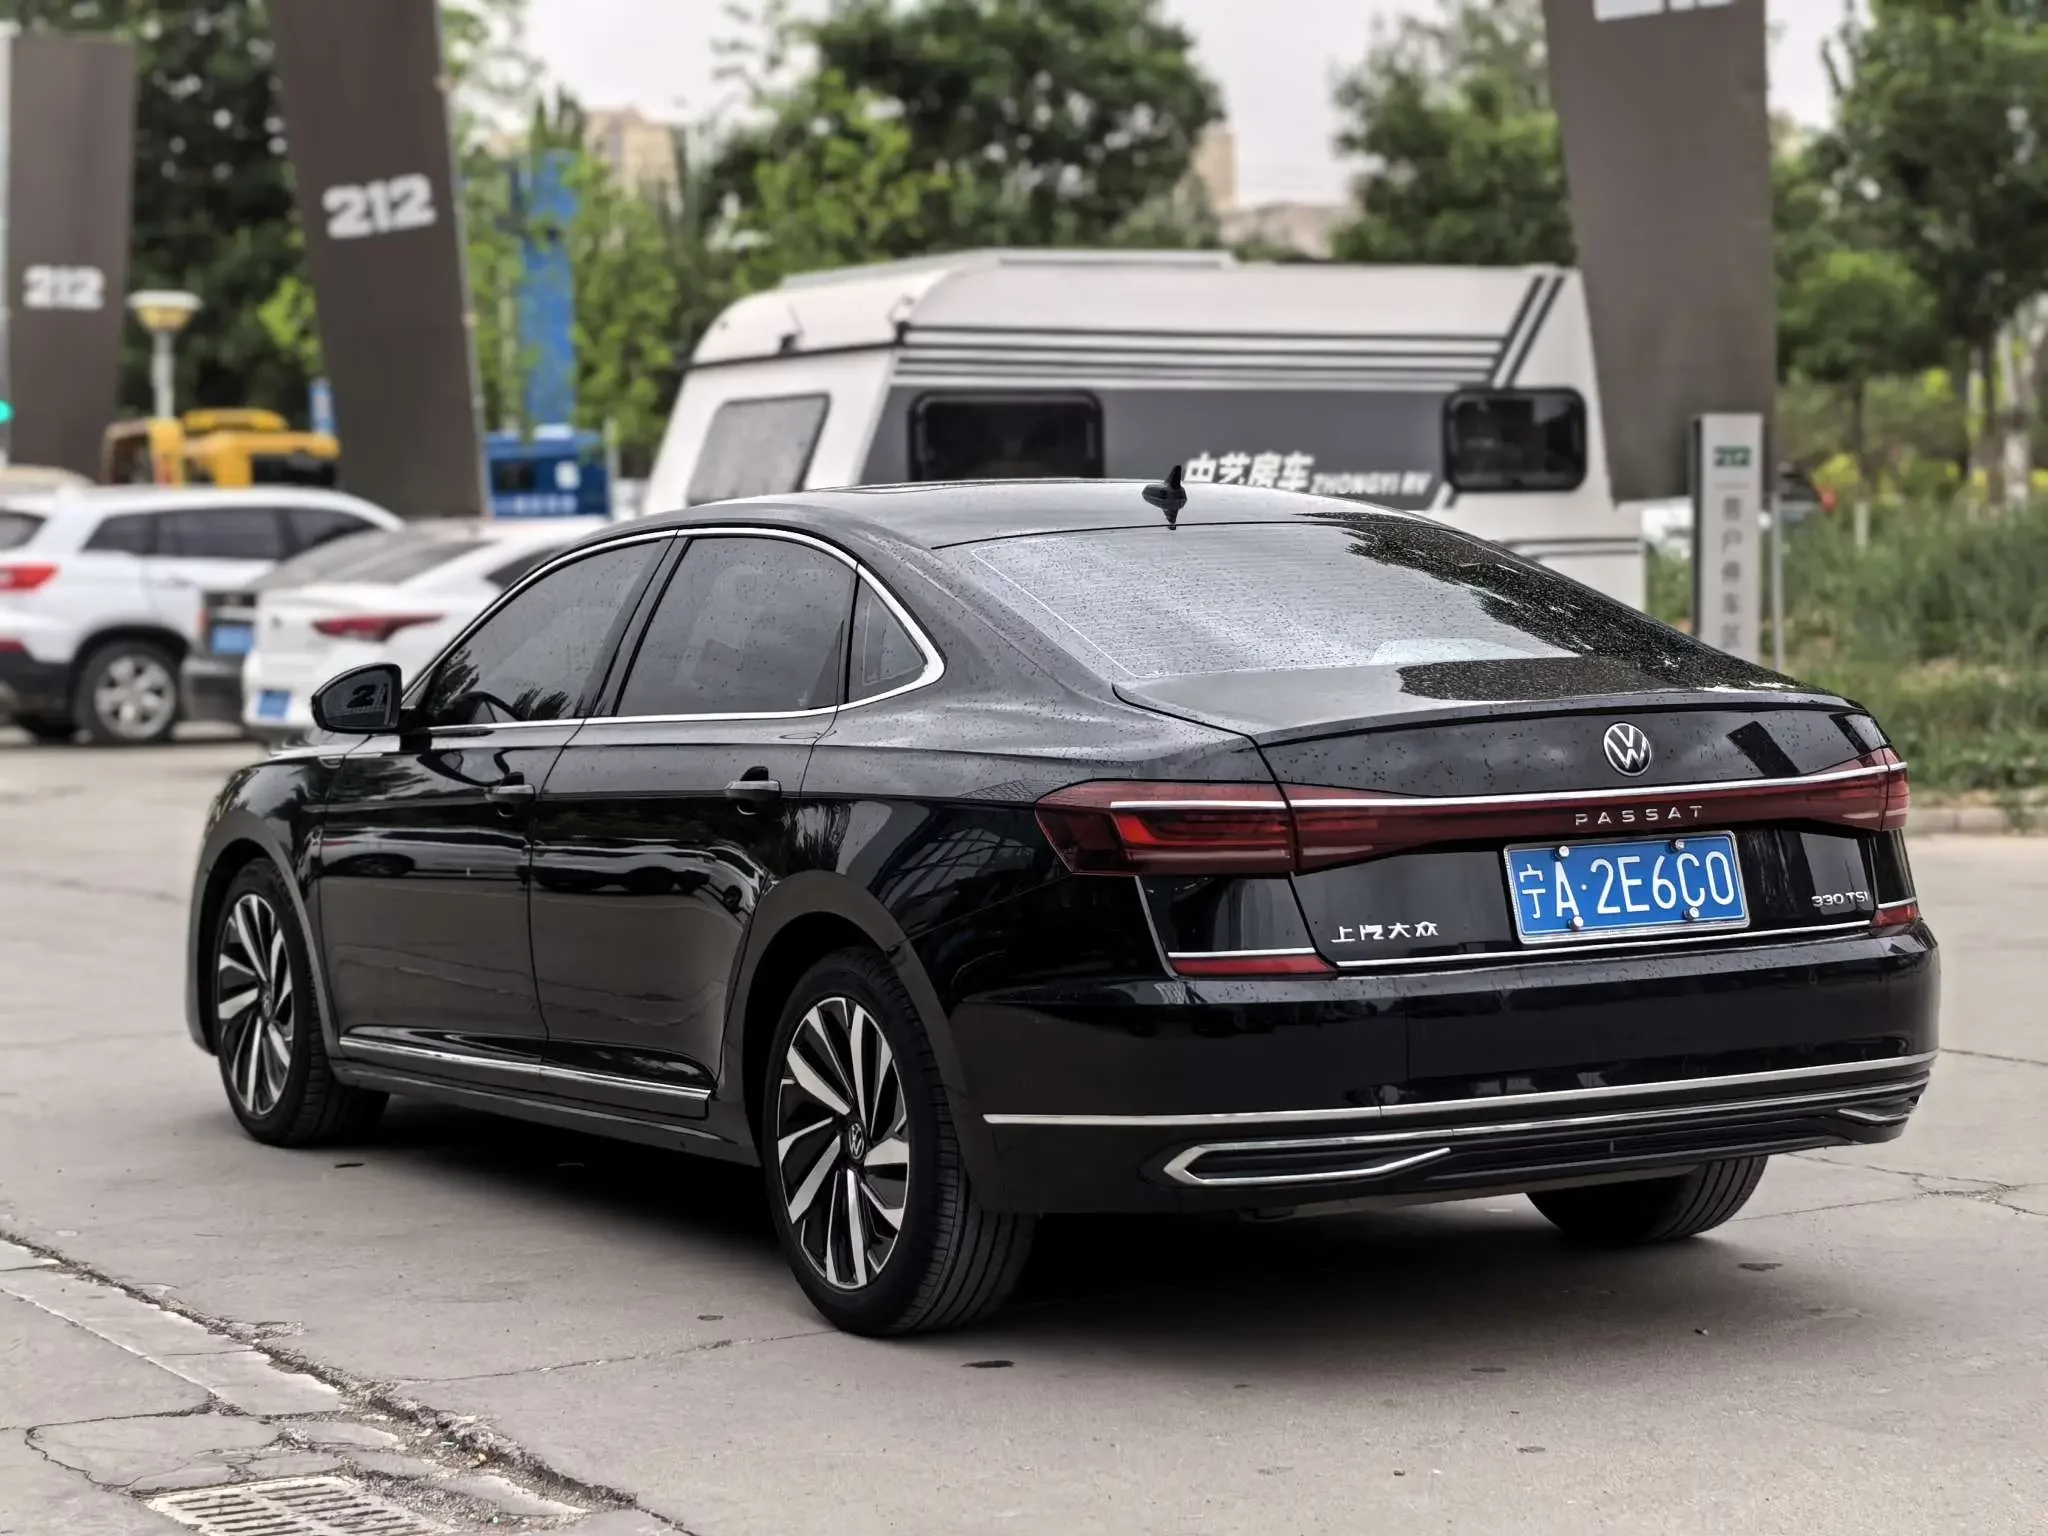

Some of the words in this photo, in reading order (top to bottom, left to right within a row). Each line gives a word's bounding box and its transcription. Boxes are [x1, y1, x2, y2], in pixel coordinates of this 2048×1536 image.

[322, 174, 435, 238] 212
[22, 264, 106, 310] 212
[1575, 805, 1702, 826] PASSAT
[1330, 921, 1440, 943] 上汽大众
